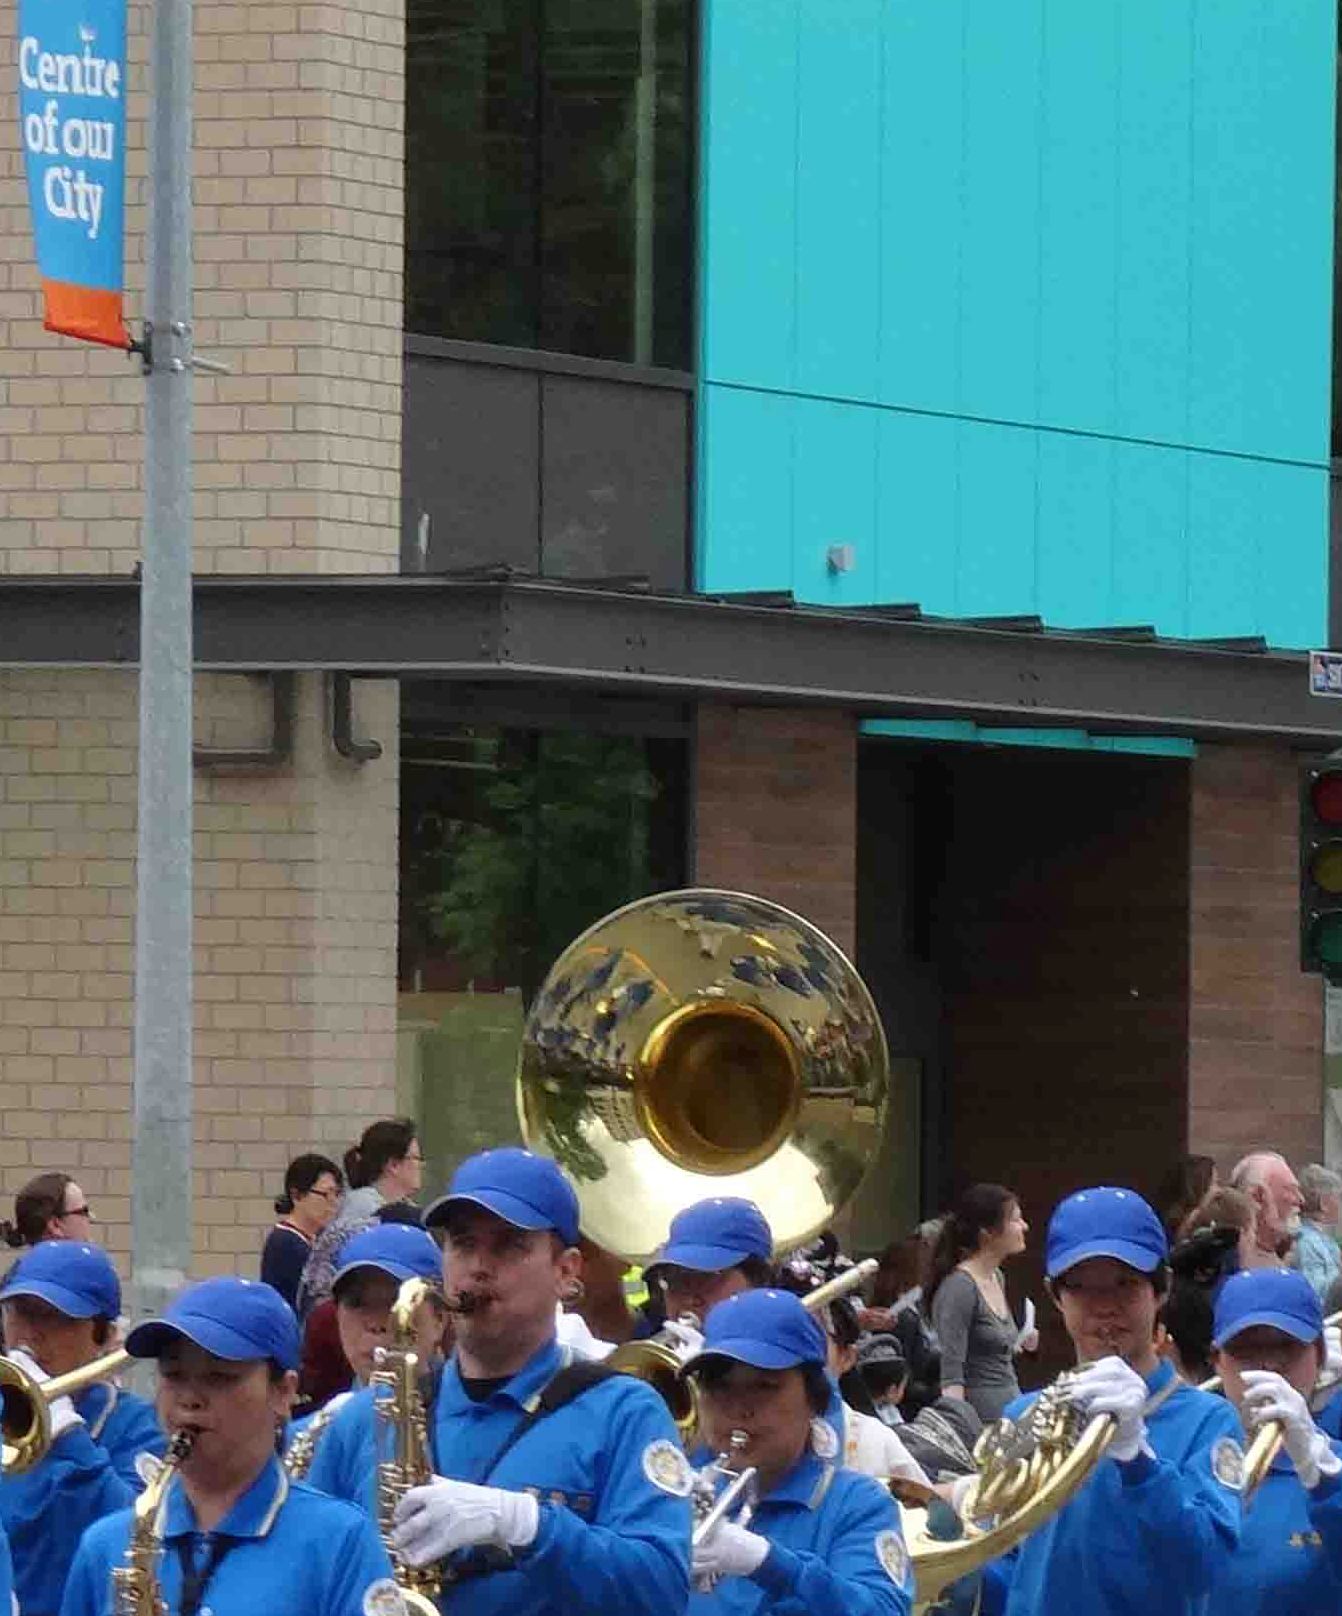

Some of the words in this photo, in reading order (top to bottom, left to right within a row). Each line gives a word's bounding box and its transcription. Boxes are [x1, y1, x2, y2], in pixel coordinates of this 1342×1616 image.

[19, 36, 121, 98] Centre
[25, 100, 59, 155] of
[62, 116, 113, 160] our
[44, 166, 103, 239] City
